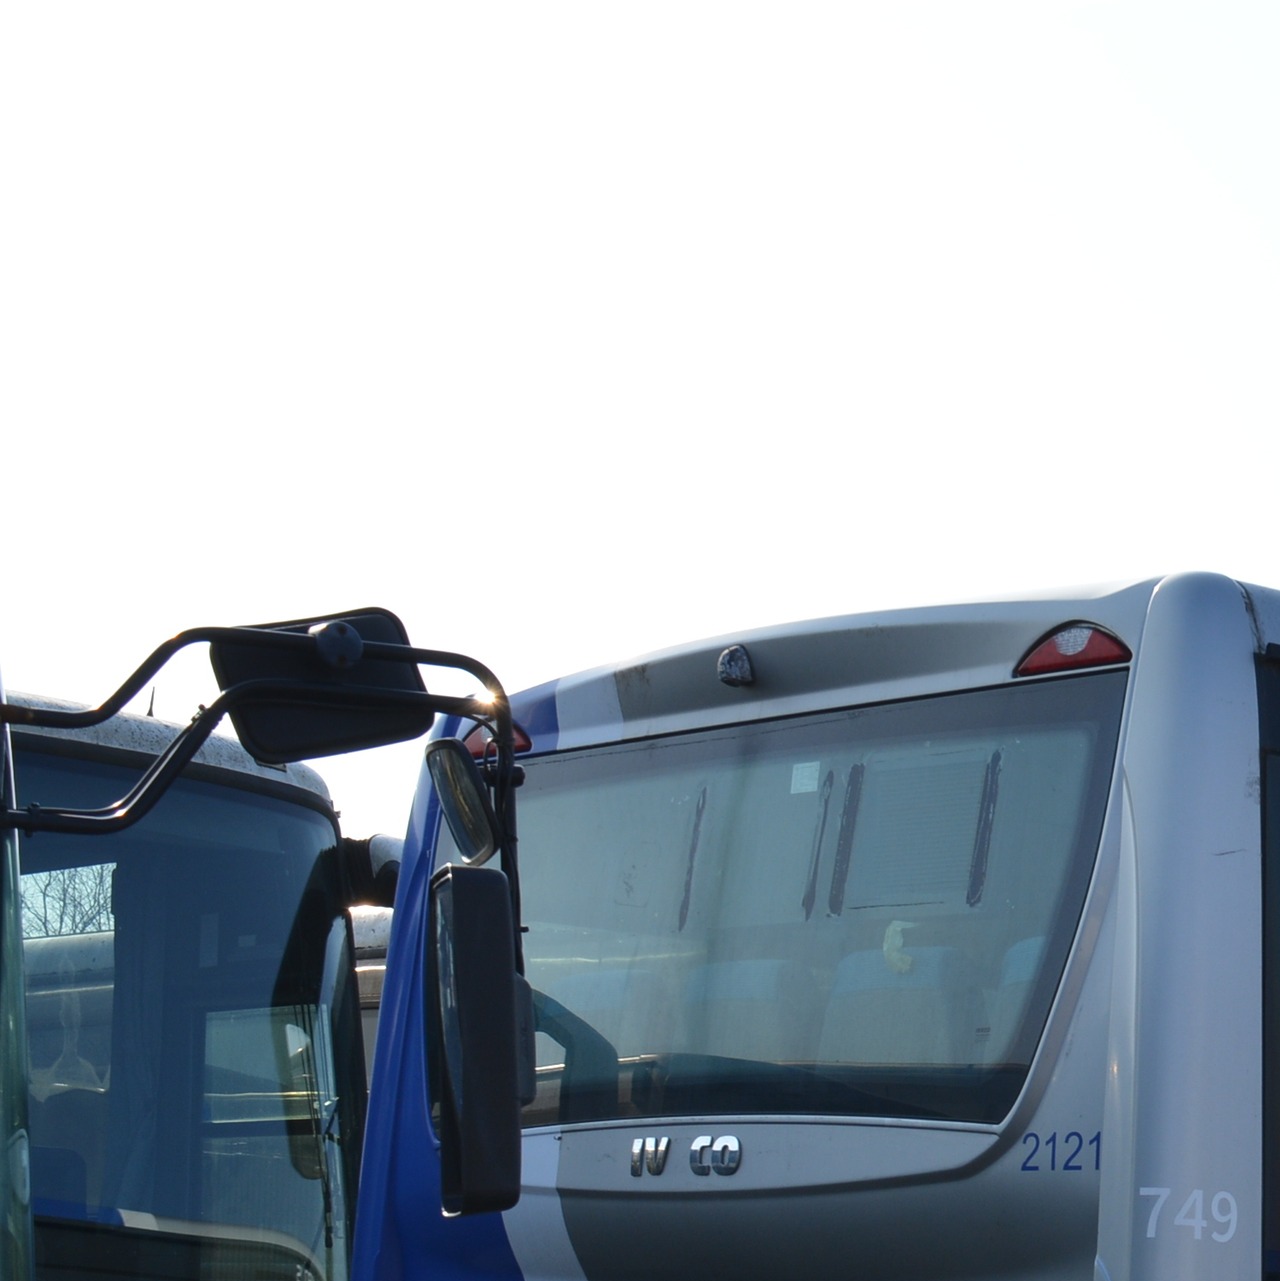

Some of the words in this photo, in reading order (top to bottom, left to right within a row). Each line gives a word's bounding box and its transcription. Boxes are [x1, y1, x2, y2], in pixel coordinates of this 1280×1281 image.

[631, 1135, 742, 1177] IVCO
[1021, 1131, 1101, 1171] 2121
[1139, 1187, 1238, 1243] 749
